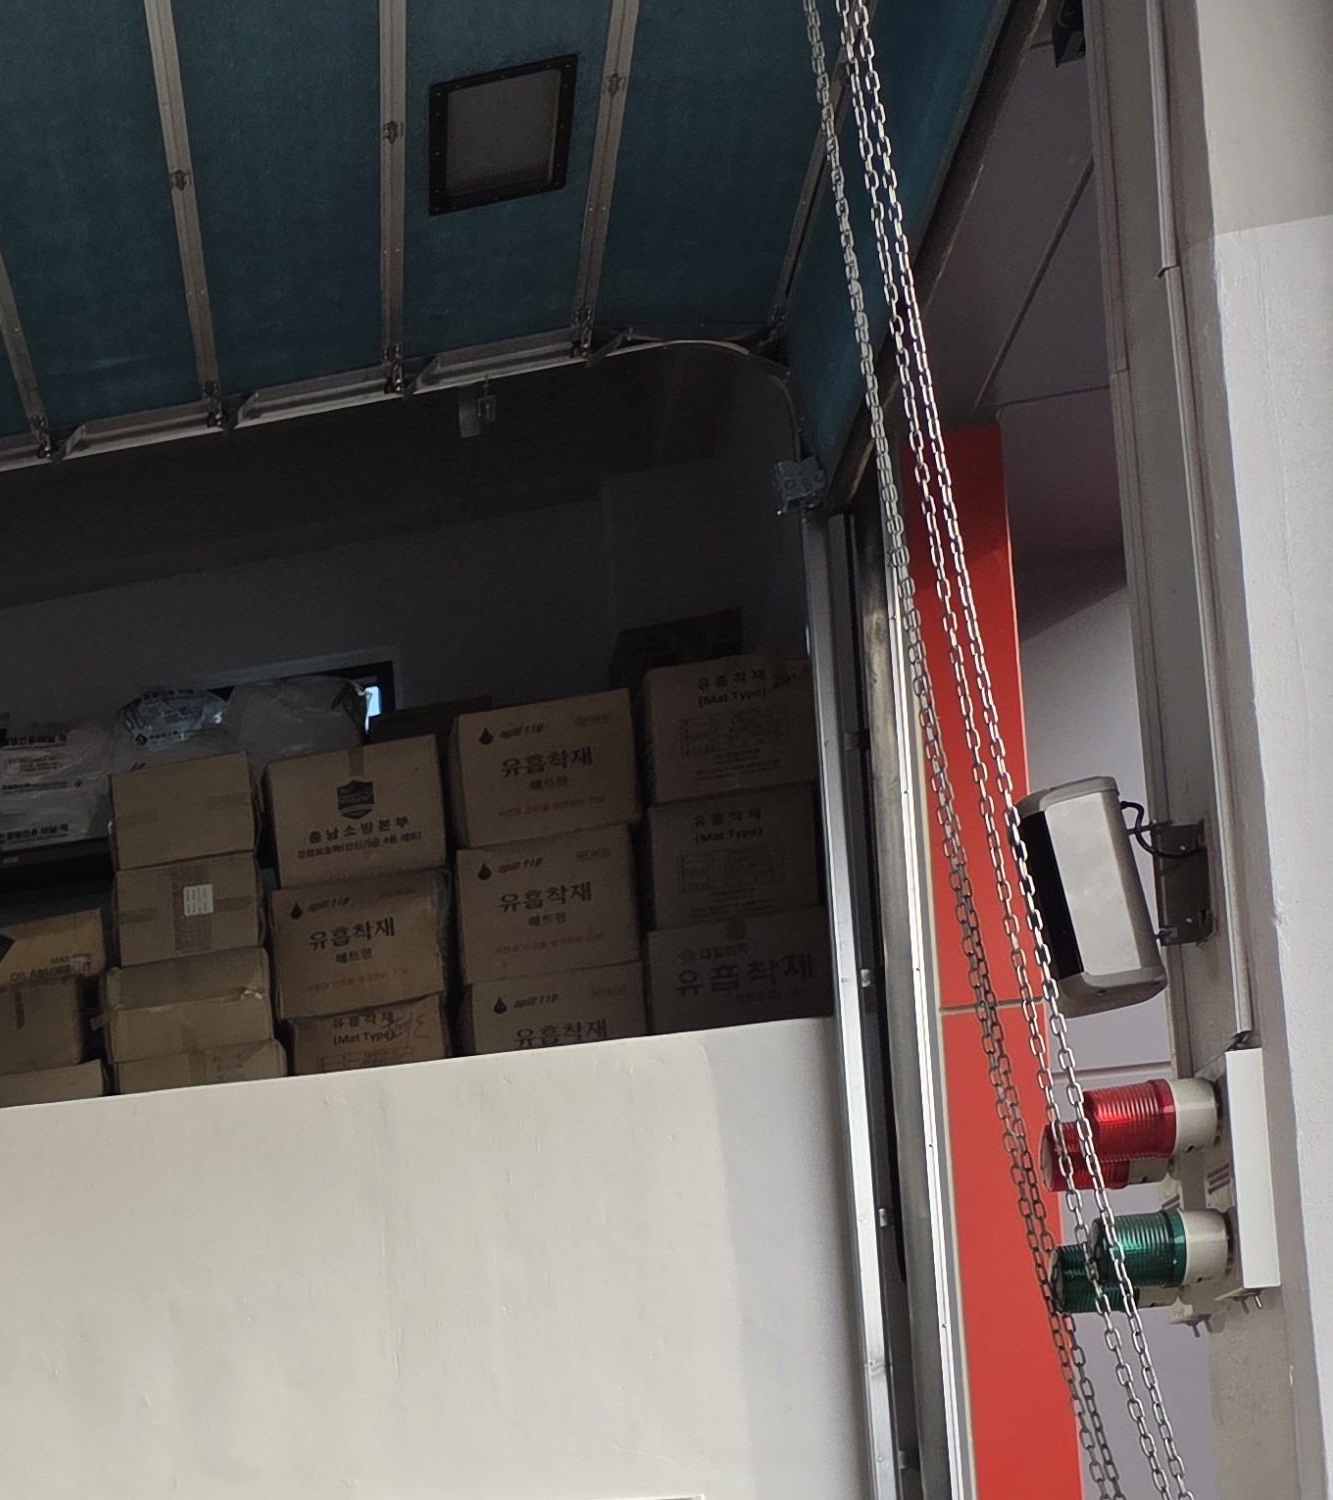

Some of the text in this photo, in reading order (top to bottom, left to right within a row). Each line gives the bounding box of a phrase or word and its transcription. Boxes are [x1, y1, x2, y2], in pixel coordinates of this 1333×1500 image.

[501, 746, 593, 778] 유흡착재
[309, 816, 409, 844] 충남소방본부
[500, 881, 592, 913] 유흡착재
[309, 916, 395, 951] 유흡착재
[516, 1018, 608, 1047] 유흡착재
